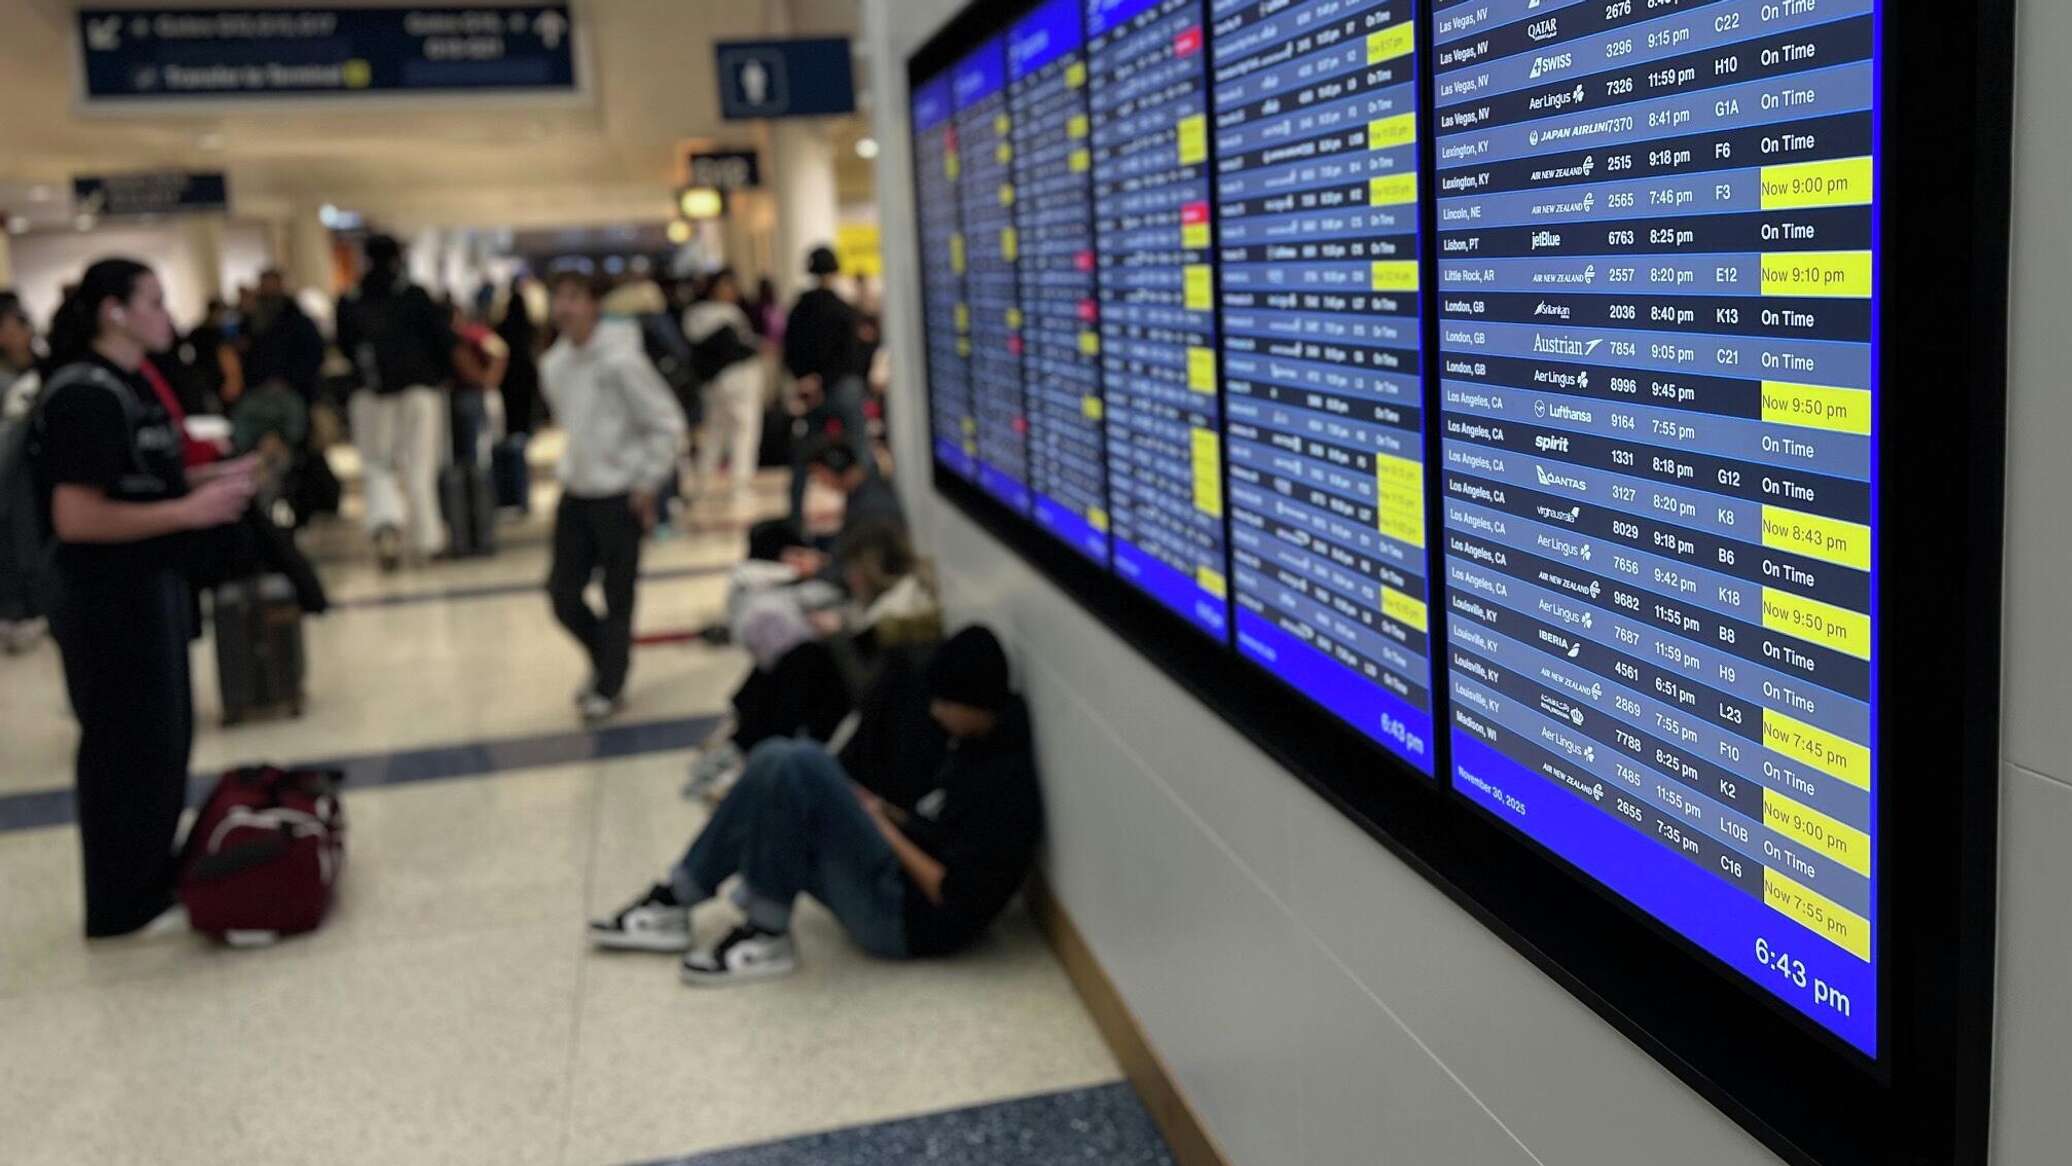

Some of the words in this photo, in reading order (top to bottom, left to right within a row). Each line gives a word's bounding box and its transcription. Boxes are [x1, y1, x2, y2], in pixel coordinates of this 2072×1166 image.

[1527, 18, 1557, 39] QATAR
[1542, 53, 1571, 72] SWISS
[1606, 39, 1631, 57] 3296
[1647, 30, 1670, 48] 9:15
[1672, 28, 1689, 45] pm
[1714, 13, 1739, 32] C22
[1761, 5, 1779, 21] On
[1782, 0, 1815, 16] Time
[1441, 116, 1454, 127] Las
[1454, 112, 1477, 126] Vegas,
[1478, 107, 1490, 120] NV
[1529, 98, 1543, 109] Aer
[1543, 92, 1570, 108] Lingus
[1606, 77, 1632, 95] 7326
[1648, 69, 1675, 87] 11:59
[1678, 68, 1694, 85] pm
[1715, 56, 1737, 75] H10
[1760, 49, 1779, 66] On
[1782, 44, 1814, 61] Time
[1540, 128, 1571, 141] JAPAN
[1605, 116, 1632, 133] 7370
[1648, 110, 1670, 126] 8:41
[1673, 110, 1689, 126] pm
[1715, 99, 1739, 116] G1A
[1442, 176, 1477, 190] Lexington,
[1478, 172, 1489, 185] KY
[1607, 155, 1631, 170] 2515
[1649, 150, 1671, 166] 9:18
[1673, 151, 1690, 166] pm
[1715, 142, 1730, 158] F6
[1608, 192, 1633, 207] 2565
[1649, 189, 1673, 204] 7:46
[1676, 191, 1692, 205] pm
[1715, 184, 1730, 199] F3
[1762, 182, 1788, 196] Now
[1792, 177, 1822, 194] 9:00
[1827, 178, 1848, 194] pm
[1531, 231, 1560, 249] jetBlue
[1608, 230, 1633, 244] 6763
[1649, 228, 1674, 243] 8:25
[1676, 231, 1693, 246] pm
[1609, 268, 1634, 281] 2557
[1650, 268, 1674, 282] 8:20
[1677, 271, 1693, 284] pm
[1716, 267, 1736, 281] E12
[1762, 268, 1788, 281] Now
[1792, 267, 1819, 282] 9:10
[1824, 271, 1844, 285] pm
[1609, 305, 1635, 319] 2036
[1650, 306, 1674, 320] 8:40
[1677, 310, 1694, 324] pm
[1716, 308, 1738, 323] K13
[1761, 309, 1779, 325] On
[1781, 311, 1814, 327] Time
[1533, 333, 1583, 355] Austrian
[1609, 341, 1635, 355] 7854
[1651, 344, 1675, 359] 9:05
[1677, 349, 1693, 363] pm
[1716, 348, 1738, 364] C21
[1610, 377, 1636, 393] 8996
[1651, 382, 1676, 398] 9:45
[1678, 388, 1694, 402] pm
[1763, 394, 1788, 410] Now
[1792, 397, 1822, 415] 9:50
[1826, 405, 1847, 420] pm
[1447, 420, 1460, 432] Los
[1460, 422, 1491, 440] Angeles,
[1491, 427, 1504, 440] CA
[1535, 435, 1568, 452] spirit
[1611, 449, 1633, 465] 1331
[1652, 457, 1675, 473] 8:18
[1677, 464, 1693, 478] pm
[1717, 469, 1740, 486] G12
[1549, 403, 1591, 422] Lufthansa
[1611, 413, 1634, 429] 9164
[1652, 419, 1676, 436] 7:55
[1678, 426, 1694, 439] pm
[1761, 436, 1779, 452] On
[1782, 439, 1814, 458] Time
[1547, 472, 1586, 490] QANTAS
[1612, 485, 1635, 501] 3127
[1653, 494, 1677, 511] 8:20
[1679, 503, 1695, 516] pm
[1718, 508, 1734, 525] K8
[1763, 519, 1788, 537] Now
[1792, 525, 1822, 545] 8:43
[1826, 536, 1846, 551] pm
[1612, 520, 1638, 539] 8029
[1653, 531, 1676, 549] 9:18
[1677, 540, 1694, 554] pm
[1718, 548, 1734, 565] B6
[1613, 556, 1638, 574] 7656
[1654, 568, 1677, 586] 9:42
[1680, 579, 1696, 592] pm
[1719, 587, 1740, 605] K18
[1764, 601, 1789, 620] Now
[1792, 609, 1822, 631] 9:50
[1827, 623, 1846, 639] pm
[1613, 591, 1639, 611] 9682
[1654, 605, 1681, 625] 11:55
[1683, 617, 1699, 631] pm
[1719, 626, 1735, 643] B8
[1762, 641, 1780, 659] On
[1782, 647, 1814, 671] Time
[1614, 625, 1639, 645] 7687
[1655, 641, 1681, 661] 11:59
[1683, 654, 1700, 669] pm
[1719, 664, 1735, 682] H9
[1452, 595, 1485, 620] Louisville,
[1486, 608, 1497, 622] KY
[1538, 629, 1568, 649] IBERIA
[1614, 662, 1638, 681] 4561
[1655, 677, 1676, 697] 6:51
[1679, 689, 1695, 705] pm
[1719, 703, 1741, 724] L23
[1764, 721, 1789, 743] Now
[1793, 733, 1822, 757] 7:45
[1827, 751, 1846, 768] pm
[1381, 712, 1406, 743] 6:43
[1406, 732, 1424, 755] pm
[1615, 695, 1640, 716] 2869
[1655, 713, 1679, 734] 7:55
[1681, 727, 1697, 742] pm
[1720, 741, 1739, 761] F10
[1763, 761, 1780, 781] On
[1783, 769, 1814, 795] Time
[1457, 766, 1491, 793] November
[1492, 786, 1504, 804] 30,
[1505, 794, 1525, 815] 2025
[1615, 729, 1641, 752] 7788
[1655, 749, 1679, 770] 8:25
[1682, 764, 1697, 780] pm
[1720, 779, 1735, 799] K2
[1616, 763, 1640, 786] 7485
[1656, 785, 1682, 808] 11:55
[1685, 802, 1700, 818] pm
[1720, 817, 1748, 842] L10B
[1617, 798, 1641, 821] 2655
[1656, 819, 1680, 843] 7:35
[1682, 837, 1698, 853] pm
[1720, 856, 1741, 877] C16
[1765, 879, 1790, 904] Now
[1794, 895, 1823, 922] 7:55
[1827, 917, 1847, 936] pm
[1755, 938, 1806, 987] 6:43
[1814, 978, 1849, 1016] pm
